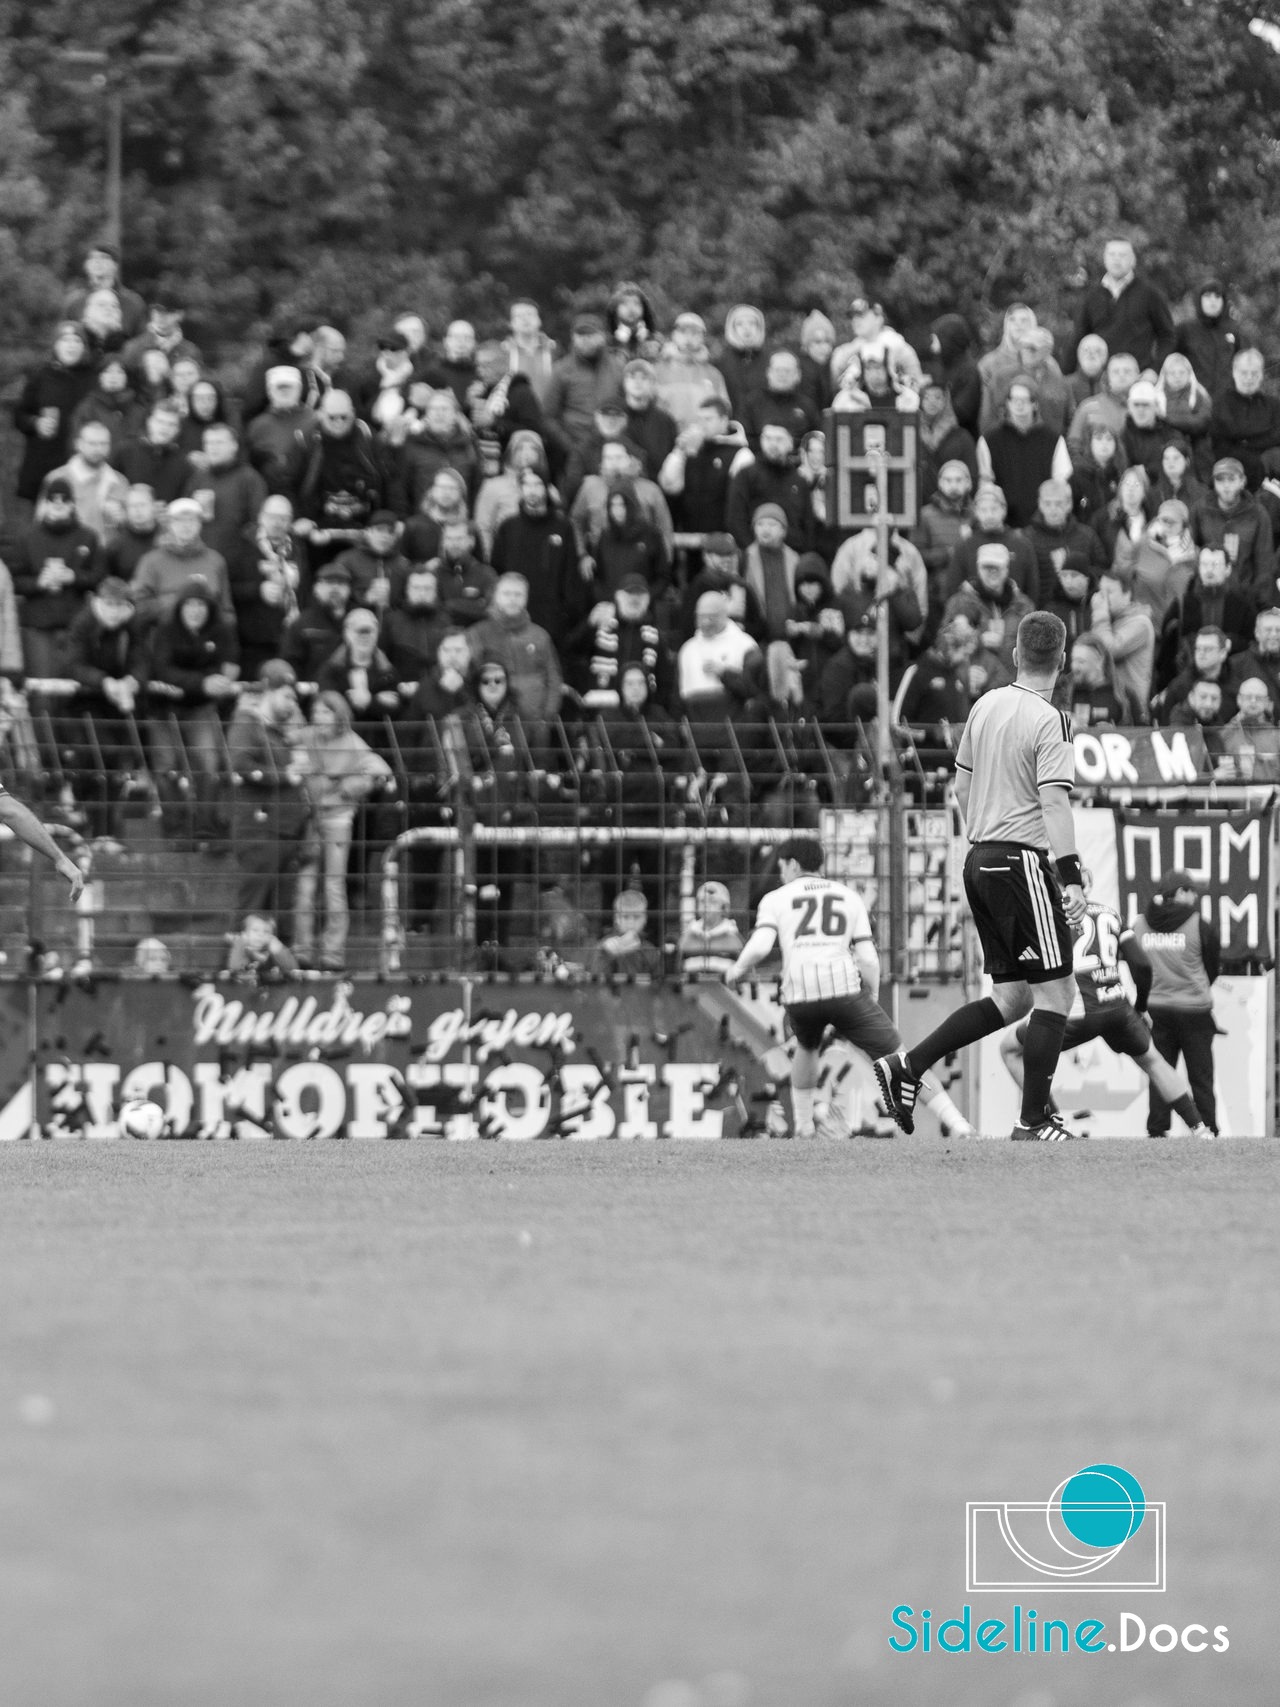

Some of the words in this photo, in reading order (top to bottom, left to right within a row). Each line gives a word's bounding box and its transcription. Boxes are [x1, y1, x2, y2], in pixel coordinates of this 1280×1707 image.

[791, 893, 848, 940] 26
[1072, 911, 1120, 973] 26
[1141, 931, 1187, 951] ORDNER
